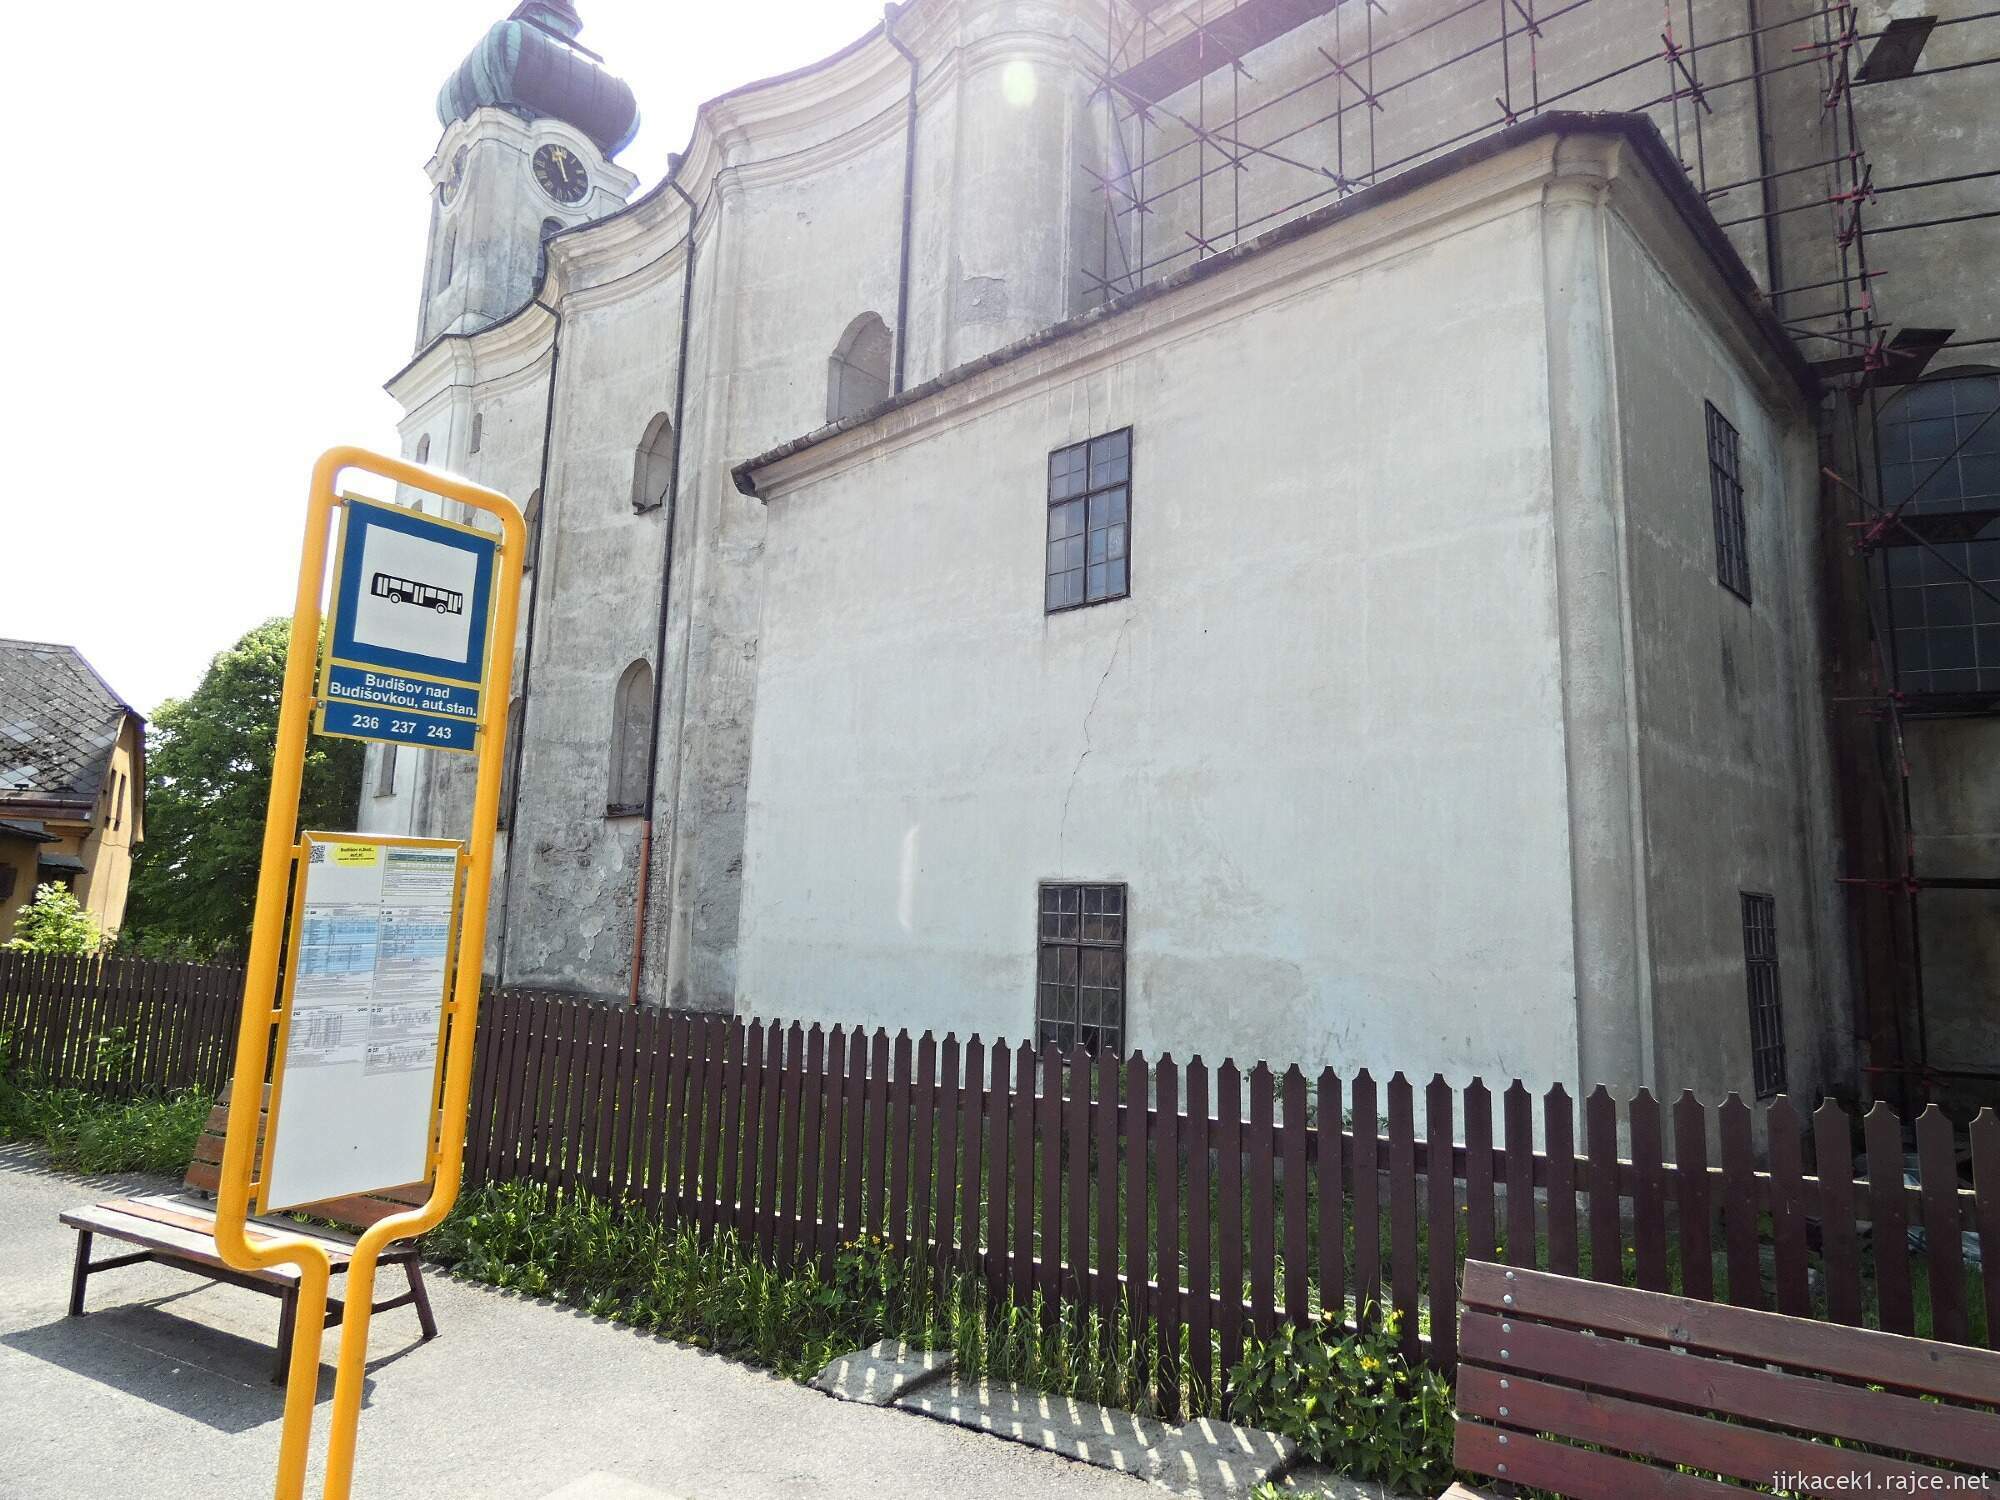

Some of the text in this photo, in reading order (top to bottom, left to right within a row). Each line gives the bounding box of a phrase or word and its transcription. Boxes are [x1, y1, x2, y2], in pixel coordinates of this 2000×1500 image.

[365, 674, 450, 699] Budišov nad
[330, 682, 477, 717] Budišovkou, aut.stan.
[352, 714, 452, 739] 236 237 243
